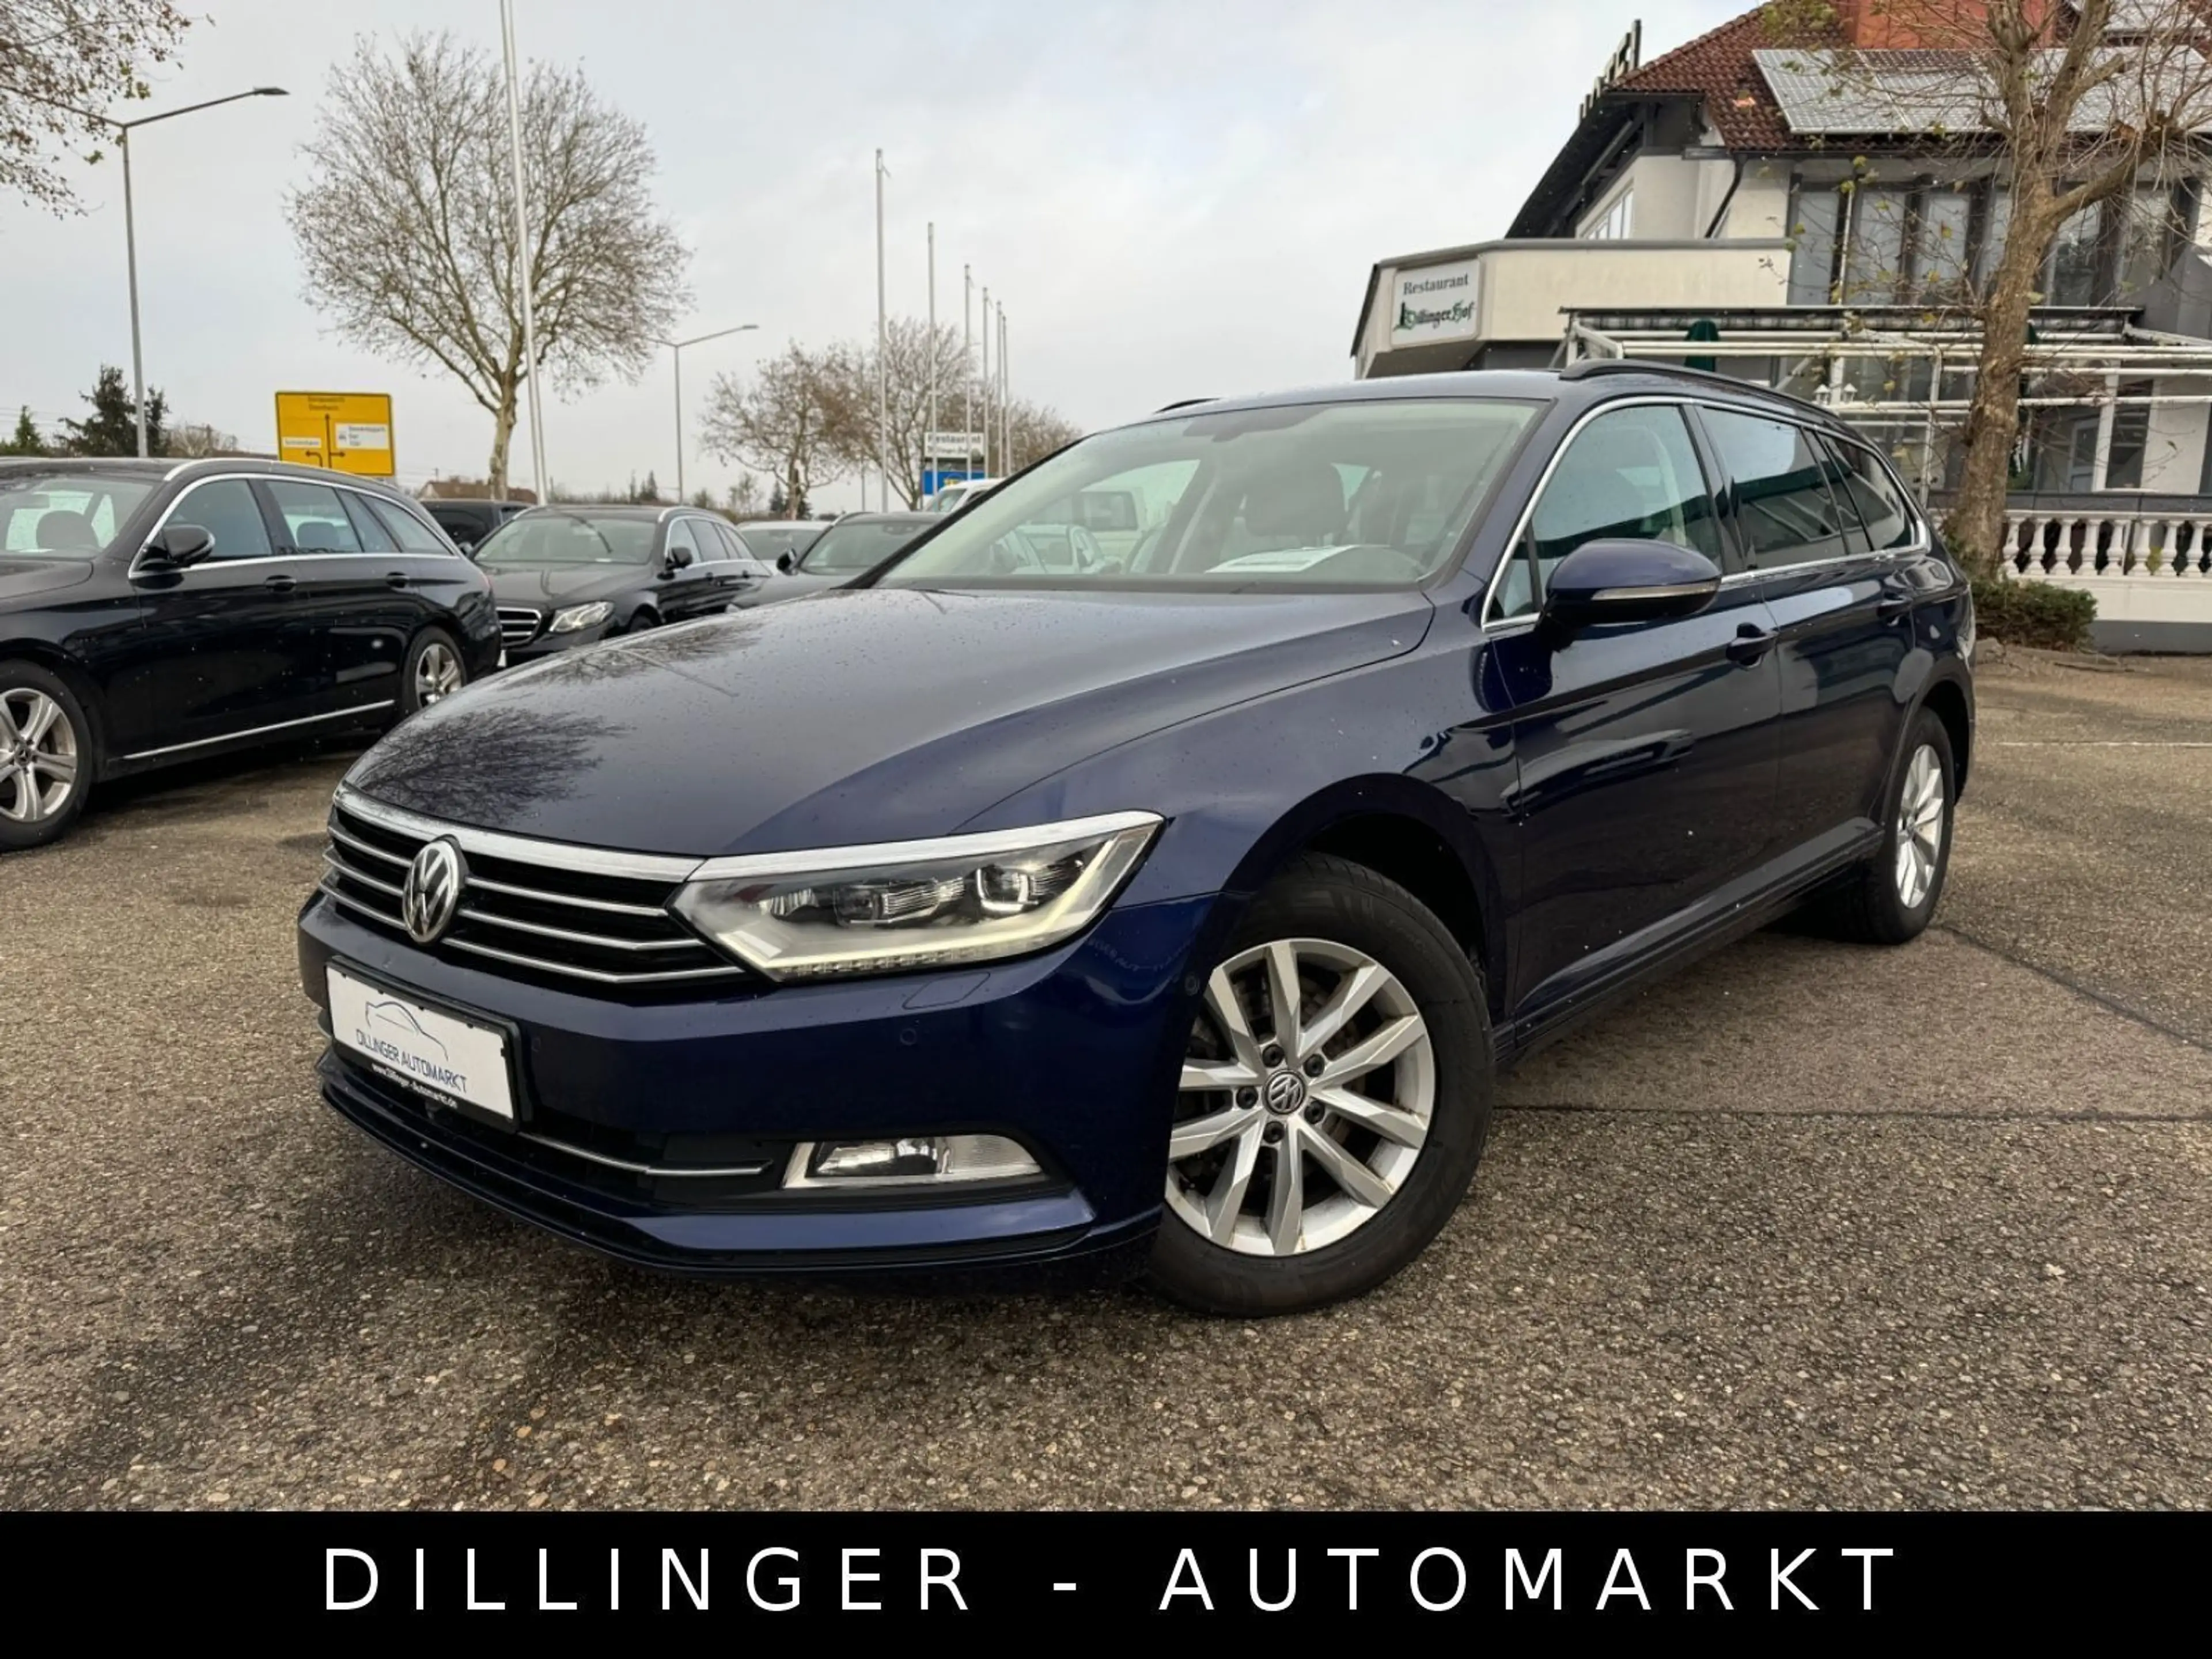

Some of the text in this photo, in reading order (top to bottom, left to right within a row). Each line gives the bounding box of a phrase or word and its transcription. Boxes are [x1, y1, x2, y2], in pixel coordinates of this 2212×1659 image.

[1403, 272, 1469, 296] Restaurant
[355, 1028, 467, 1093] DILLINGER AUTOMARKT
